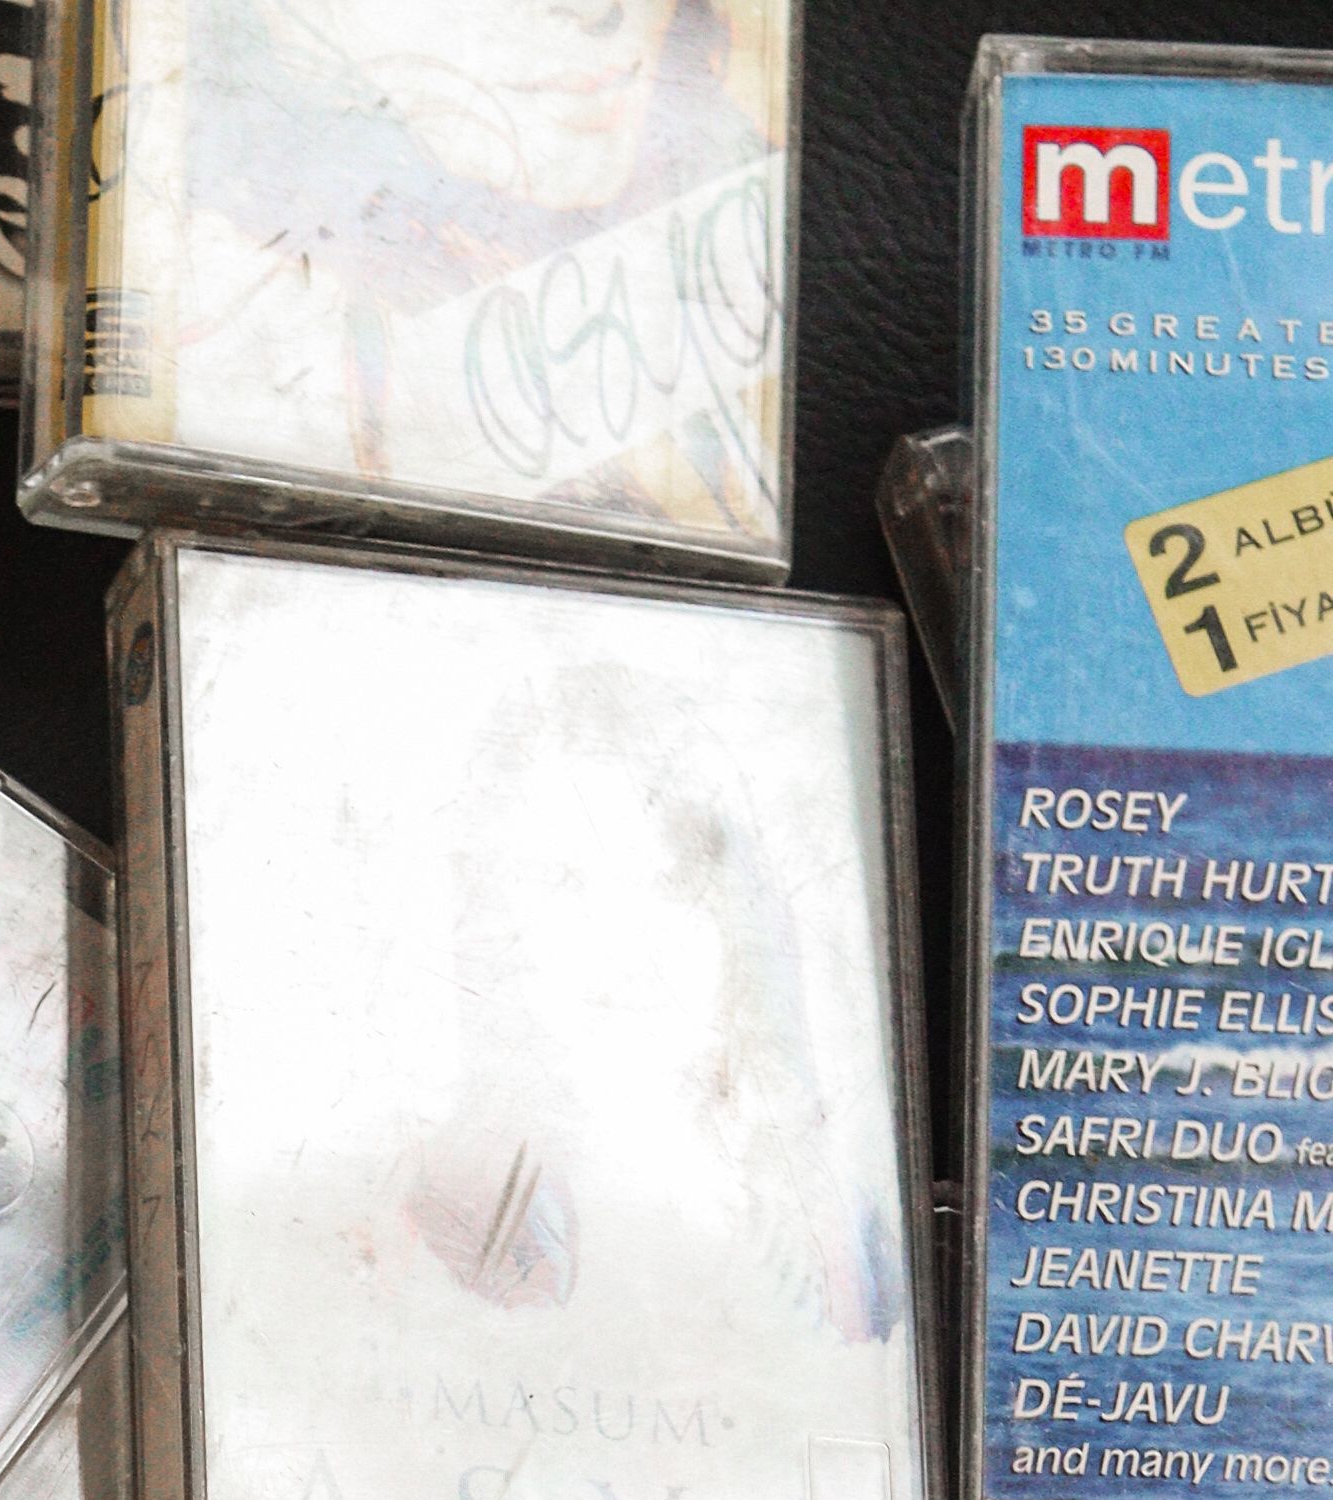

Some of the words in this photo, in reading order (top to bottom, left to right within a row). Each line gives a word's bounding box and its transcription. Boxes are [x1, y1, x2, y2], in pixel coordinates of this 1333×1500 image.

[1031, 311, 1089, 334] 35
[1025, 348, 1095, 373] 130
[1147, 524, 1219, 600] 2
[1020, 787, 1187, 836] ROSEY
[1021, 851, 1185, 900] TRUTH
[1019, 917, 1244, 971] ENRIQUE
[1017, 982, 1203, 1032] SOPHIE
[1016, 1048, 1161, 1095] MARY
[1016, 1113, 1157, 1161] SAFRI
[1171, 1120, 1283, 1166] DUO
[1015, 1178, 1277, 1233] CHRISTINA
[1010, 1243, 1263, 1297] JEANETTE
[1015, 1309, 1169, 1359] DAVID
[1013, 1373, 1230, 1429] DÉ-JAVU
